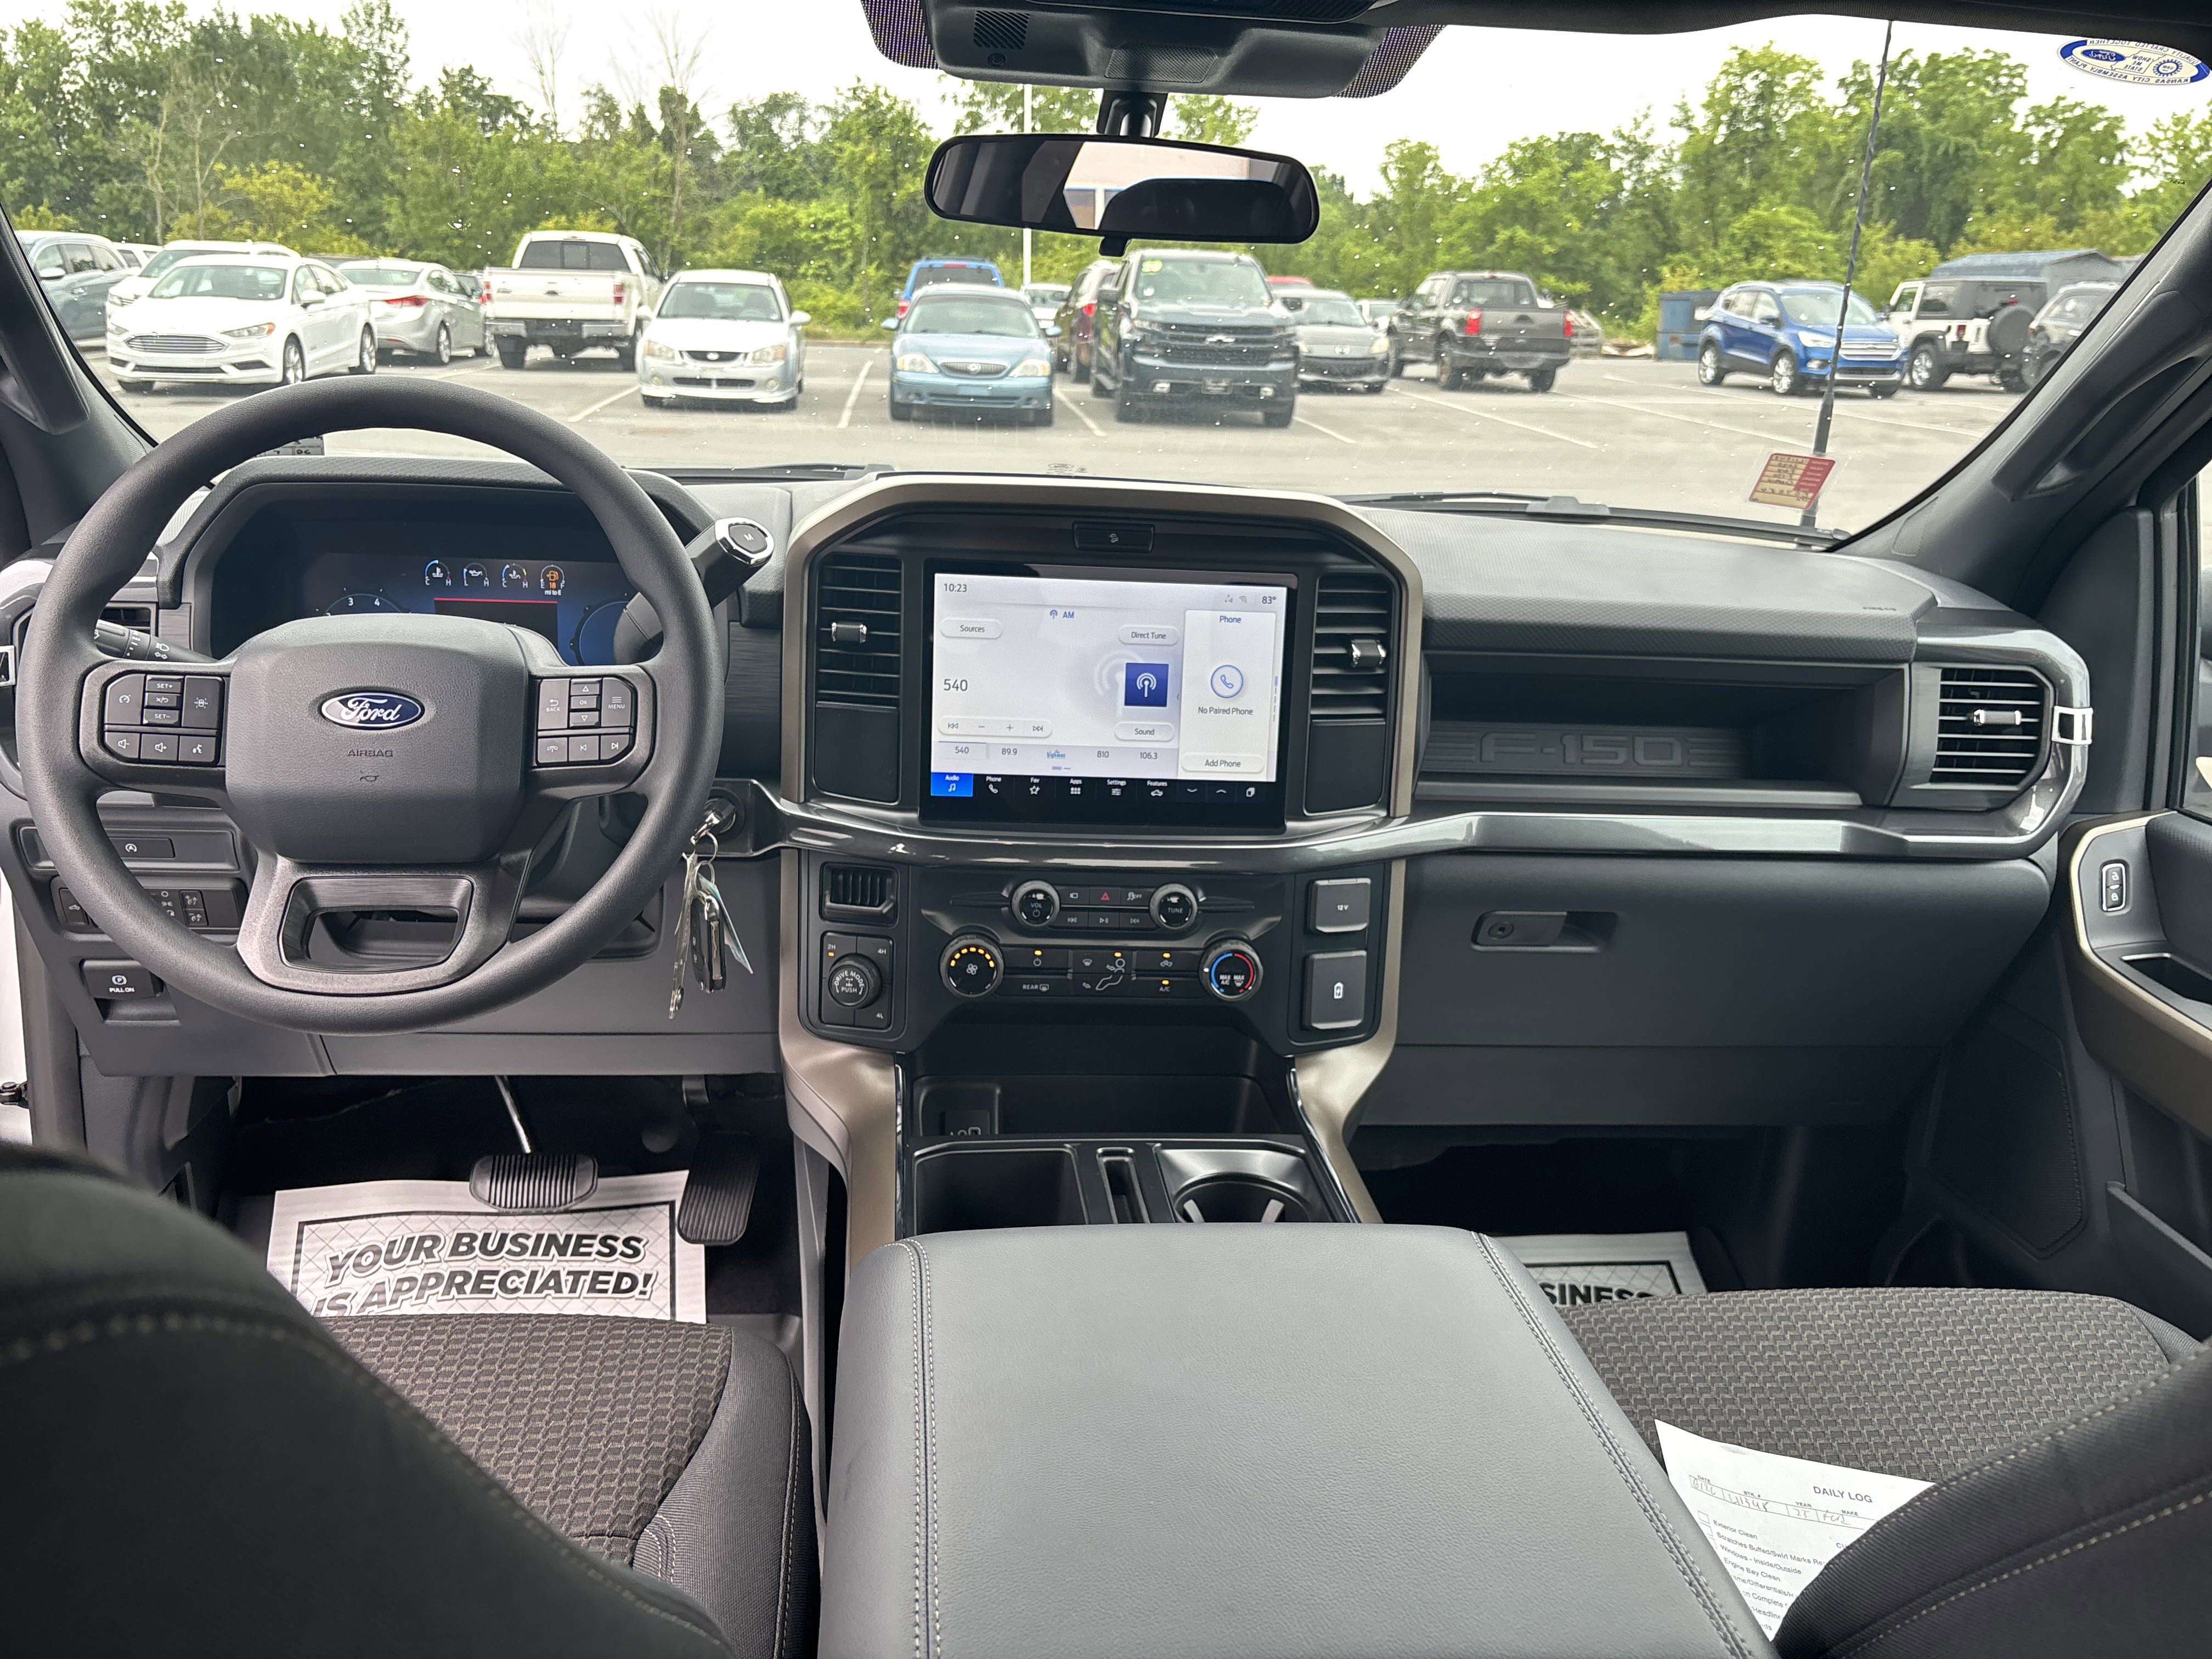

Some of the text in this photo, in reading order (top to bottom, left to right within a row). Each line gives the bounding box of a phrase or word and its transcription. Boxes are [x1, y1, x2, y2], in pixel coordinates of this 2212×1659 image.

[743, 533, 754, 541] M
[944, 583, 967, 592] 10:23
[348, 597, 354, 606] 3
[374, 598, 380, 607] 4
[1220, 616, 1242, 624] Phone
[960, 625, 985, 633] Sources
[944, 679, 968, 691] 540
[341, 697, 402, 721] Ford
[1209, 707, 1230, 715] Paired
[1232, 707, 1253, 715] Phone
[1480, 732, 1683, 765] F-150
[1220, 760, 1241, 768] Phone
[834, 970, 865, 987] DRIVE MODE
[328, 1232, 646, 1285] YOUR BUSINESS
[357, 1270, 654, 1313] APPRECIATED!
[1813, 1486, 1873, 1503] DAILY LOG
[1713, 1520, 1758, 1539] Exterior Clean
[1717, 1532, 1747, 1549] Scratches
[1790, 1554, 1811, 1564] Marks
[1720, 1544, 1748, 1561] Windows
[1753, 1558, 1802, 1575] Inside/Outside
[1724, 1558, 1781, 1582] Engine Bay Clean
[1752, 1593, 1784, 1608] Complete
